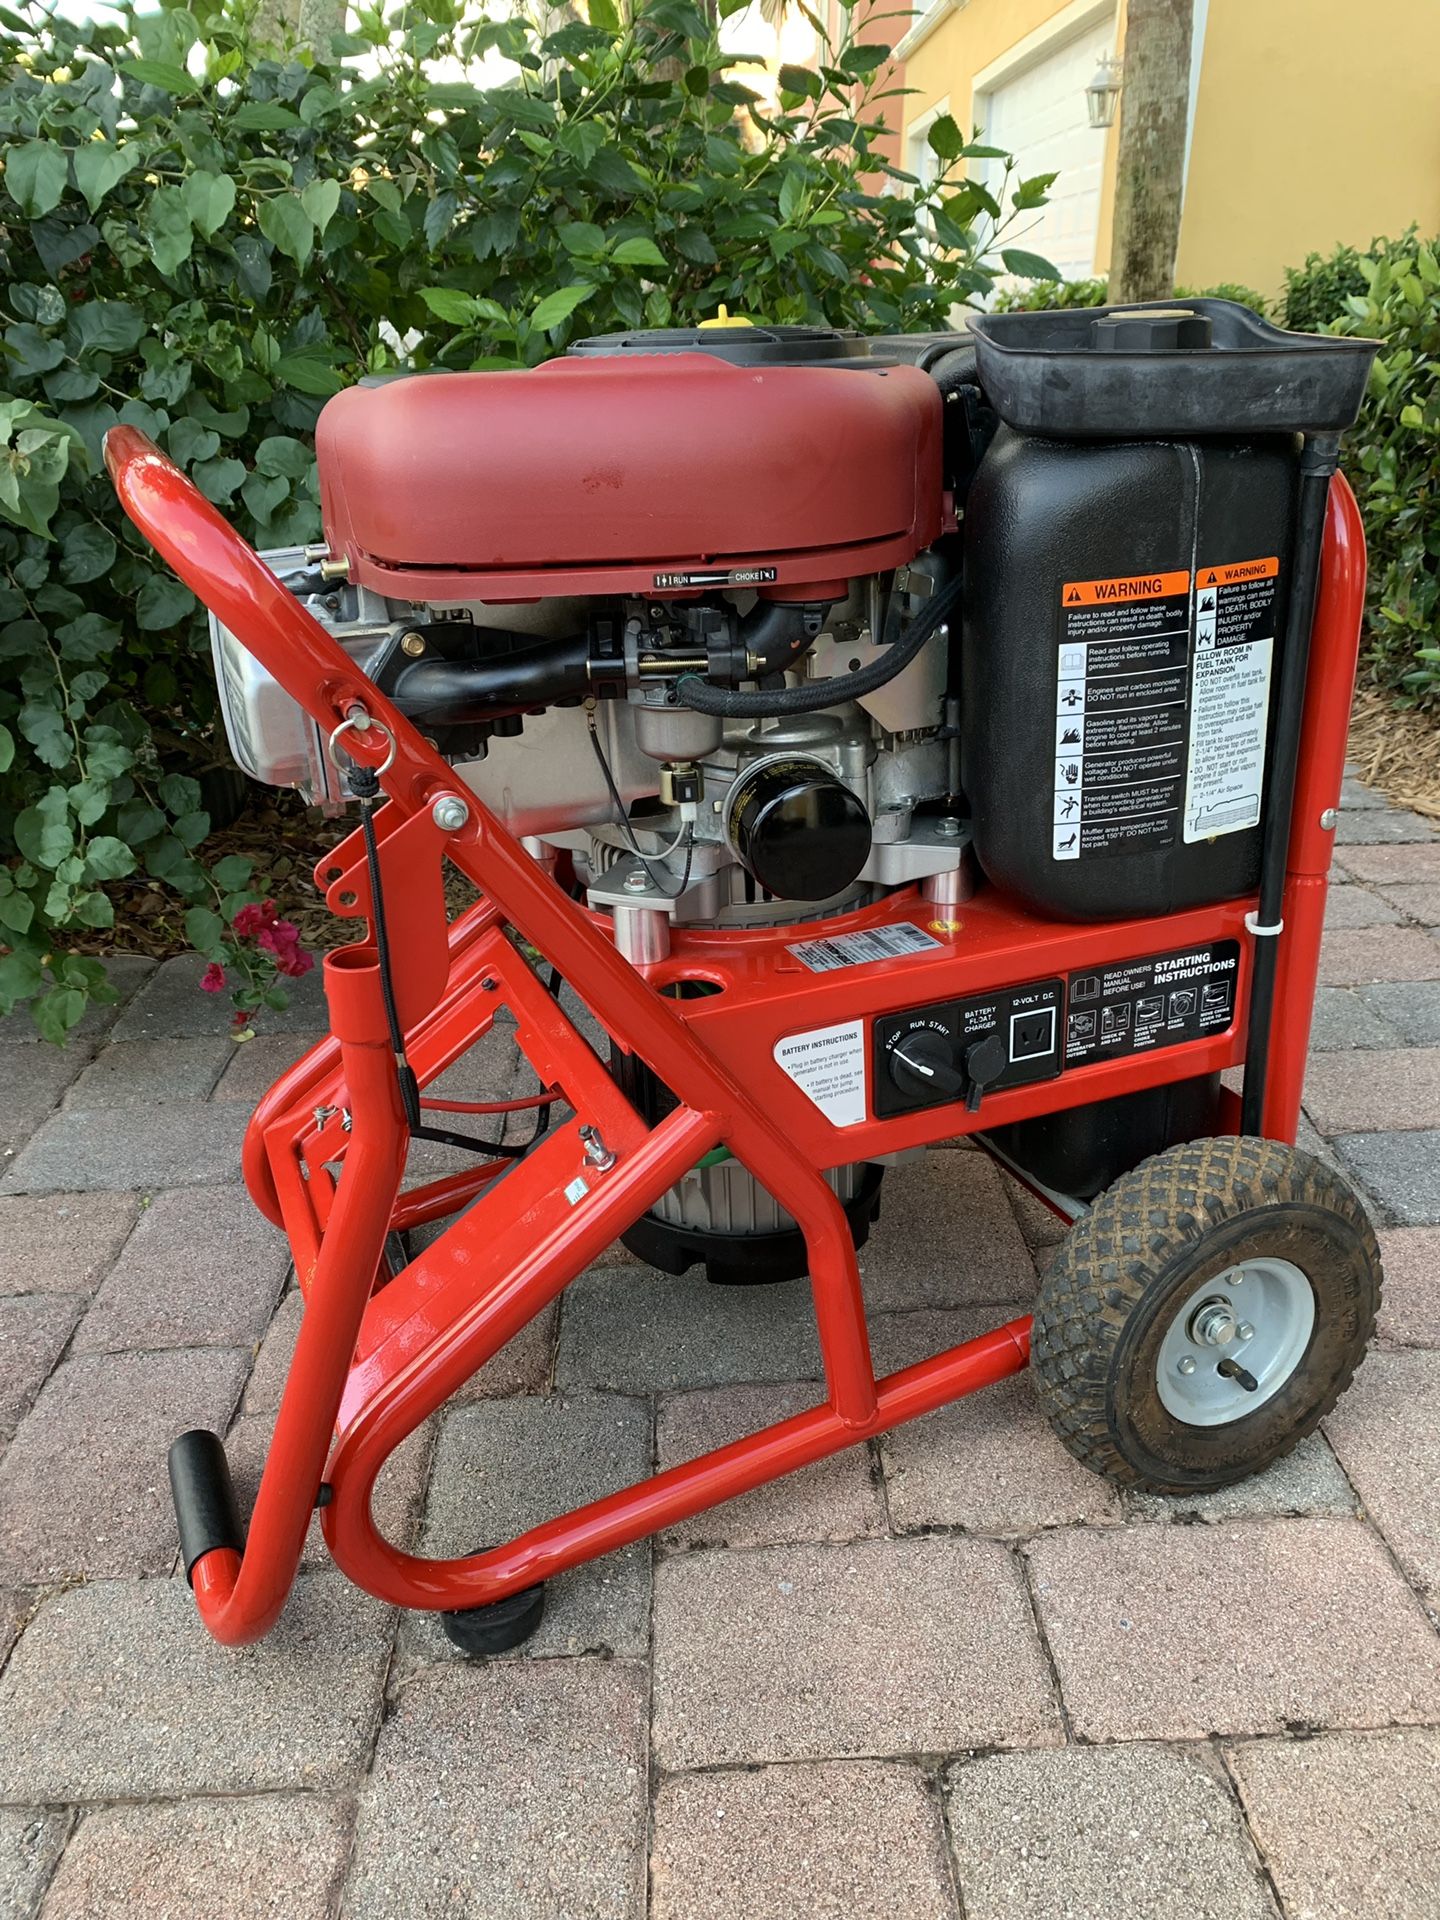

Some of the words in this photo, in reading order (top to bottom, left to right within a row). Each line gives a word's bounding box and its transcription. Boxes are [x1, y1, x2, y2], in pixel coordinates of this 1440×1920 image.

[673, 576, 688, 584] RUN
[735, 573, 760, 581] CHOKE
[1224, 565, 1267, 580] WARNING
[1094, 578, 1162, 600] WARNING
[1218, 584, 1240, 595] Failure
[1241, 583, 1248, 591] to
[1248, 580, 1265, 590] follow
[1266, 578, 1274, 586] all
[1218, 593, 1246, 607] warnings
[1259, 588, 1275, 598] result
[1068, 612, 1091, 621] Failure
[1092, 611, 1099, 619] to
[1100, 610, 1116, 618] read
[1117, 608, 1129, 616] and
[1130, 606, 1148, 614] follow
[1217, 614, 1242, 625] INJURY
[1243, 610, 1262, 620] and/or
[1218, 607, 1224, 615] in
[1067, 618, 1105, 629] instructions
[1120, 615, 1138, 623] result
[1166, 609, 1183, 619] bodily
[1067, 628, 1086, 637] injury
[1087, 625, 1108, 634] and/or
[1109, 623, 1136, 633] property
[1217, 622, 1253, 635] PROPERTY
[1088, 647, 1107, 656] Read
[1122, 644, 1140, 652] follow
[1141, 641, 1169, 651] operating
[1088, 653, 1125, 663] instructions
[1126, 650, 1147, 659] before
[1148, 648, 1170, 658] running
[1197, 650, 1222, 662] ALLOW
[1223, 646, 1244, 657] ROOM
[1245, 644, 1253, 652] IN
[1196, 660, 1214, 671] FUEL
[1216, 656, 1234, 667] TANK
[1235, 653, 1249, 663] FOR
[1196, 665, 1236, 680] EXPANSION
[1087, 686, 1114, 697] Engines
[1115, 684, 1129, 692] emit
[1130, 681, 1152, 690] carbon
[1100, 693, 1115, 701] NOT
[1136, 687, 1163, 696] enclosed
[1085, 725, 1117, 736] extremely
[1152, 719, 1168, 727] Allow
[1086, 718, 1115, 728] Gasoline
[1138, 714, 1158, 723] vapors
[1085, 733, 1108, 743] engine
[1117, 730, 1130, 738] cool
[1139, 727, 1153, 735] least
[1159, 724, 1182, 732] minutes
[1085, 741, 1106, 749] before
[1084, 759, 1117, 769] Generator
[1118, 755, 1146, 766] produces
[1147, 752, 1172, 762] powerful
[1123, 763, 1138, 771] NOT
[1139, 760, 1161, 770] operate
[1083, 802, 1101, 810] when
[1102, 797, 1135, 808] connecting
[1136, 793, 1164, 804] generator
[1084, 793, 1110, 803] Transfer
[1111, 791, 1130, 799] switch
[1131, 788, 1150, 796] MUST
[1082, 827, 1103, 836] Muffler
[1120, 820, 1155, 832] temperature
[1082, 834, 1105, 842] exceed
[1155, 952, 1210, 973] STARTING
[1103, 971, 1122, 981] READ
[1123, 965, 1152, 977] OWNERS
[1154, 959, 1235, 985] INSTRUCTIONS
[1103, 977, 1131, 989] MANUAL
[1103, 985, 1129, 996] BEFORE
[1131, 981, 1146, 990] USE!
[1012, 995, 1038, 1007] 12-VOLT
[1043, 992, 1055, 1000] D.C.
[964, 1006, 996, 1019] BATTERY
[970, 1014, 992, 1025] FLOAT
[909, 1020, 926, 1030] RUN
[928, 1020, 950, 1036] START
[964, 1021, 996, 1033] CHARGER
[1149, 1022, 1165, 1030] CHOKE
[886, 1030, 902, 1050] STOP
[1101, 1033, 1117, 1041] CHECK
[1134, 1030, 1149, 1038] LEVER
[782, 1043, 810, 1056] BATTERY
[812, 1032, 858, 1049] INSTRUCTIONS
[1066, 1043, 1096, 1053] GENERATOR
[1066, 1050, 1087, 1059] OUTSIDE
